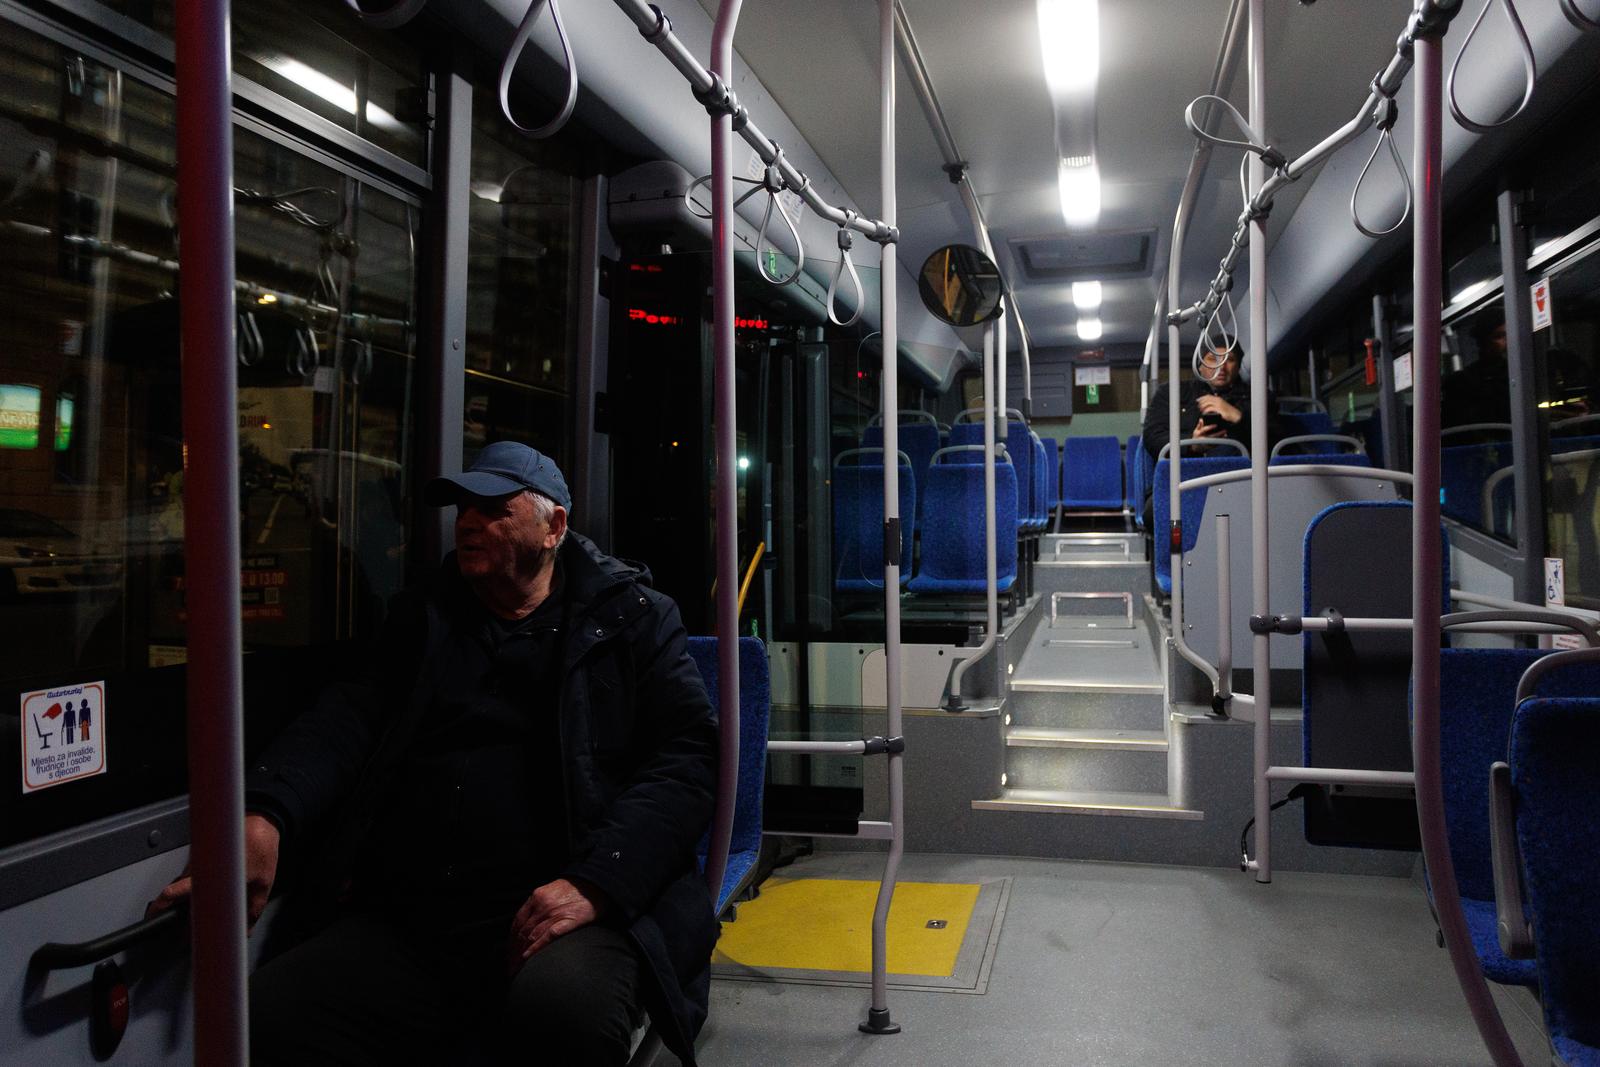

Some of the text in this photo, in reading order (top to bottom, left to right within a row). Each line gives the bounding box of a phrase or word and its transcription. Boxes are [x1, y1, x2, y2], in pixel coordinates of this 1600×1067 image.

[31, 755, 55, 767] Mjesto
[57, 753, 66, 761] za
[36, 760, 65, 774] trudnice
[70, 755, 91, 766] osobe
[55, 765, 80, 778] djecom
